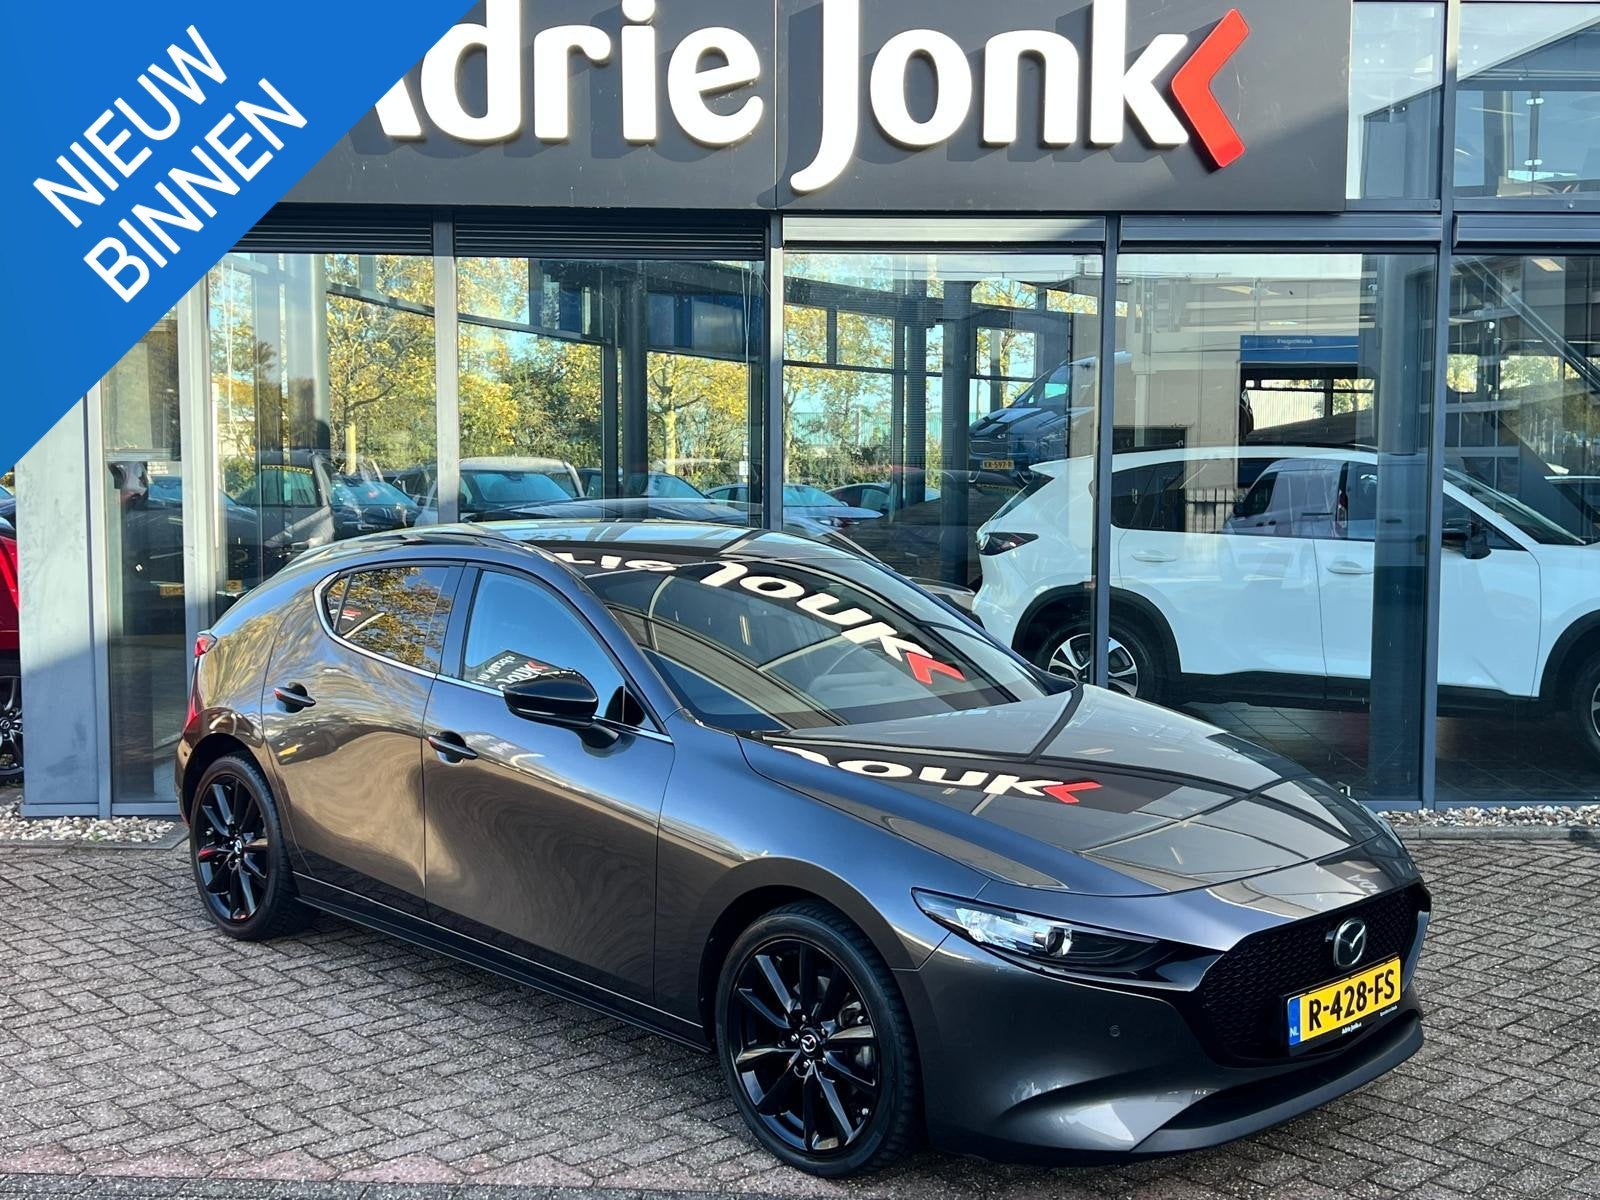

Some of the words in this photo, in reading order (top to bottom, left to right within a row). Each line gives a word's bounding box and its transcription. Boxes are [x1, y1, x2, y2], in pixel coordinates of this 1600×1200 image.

[790, 0, 1190, 192] Jonk
[1289, 1026, 1300, 1038] NL
[1309, 968, 1394, 1032] R-428-FS
